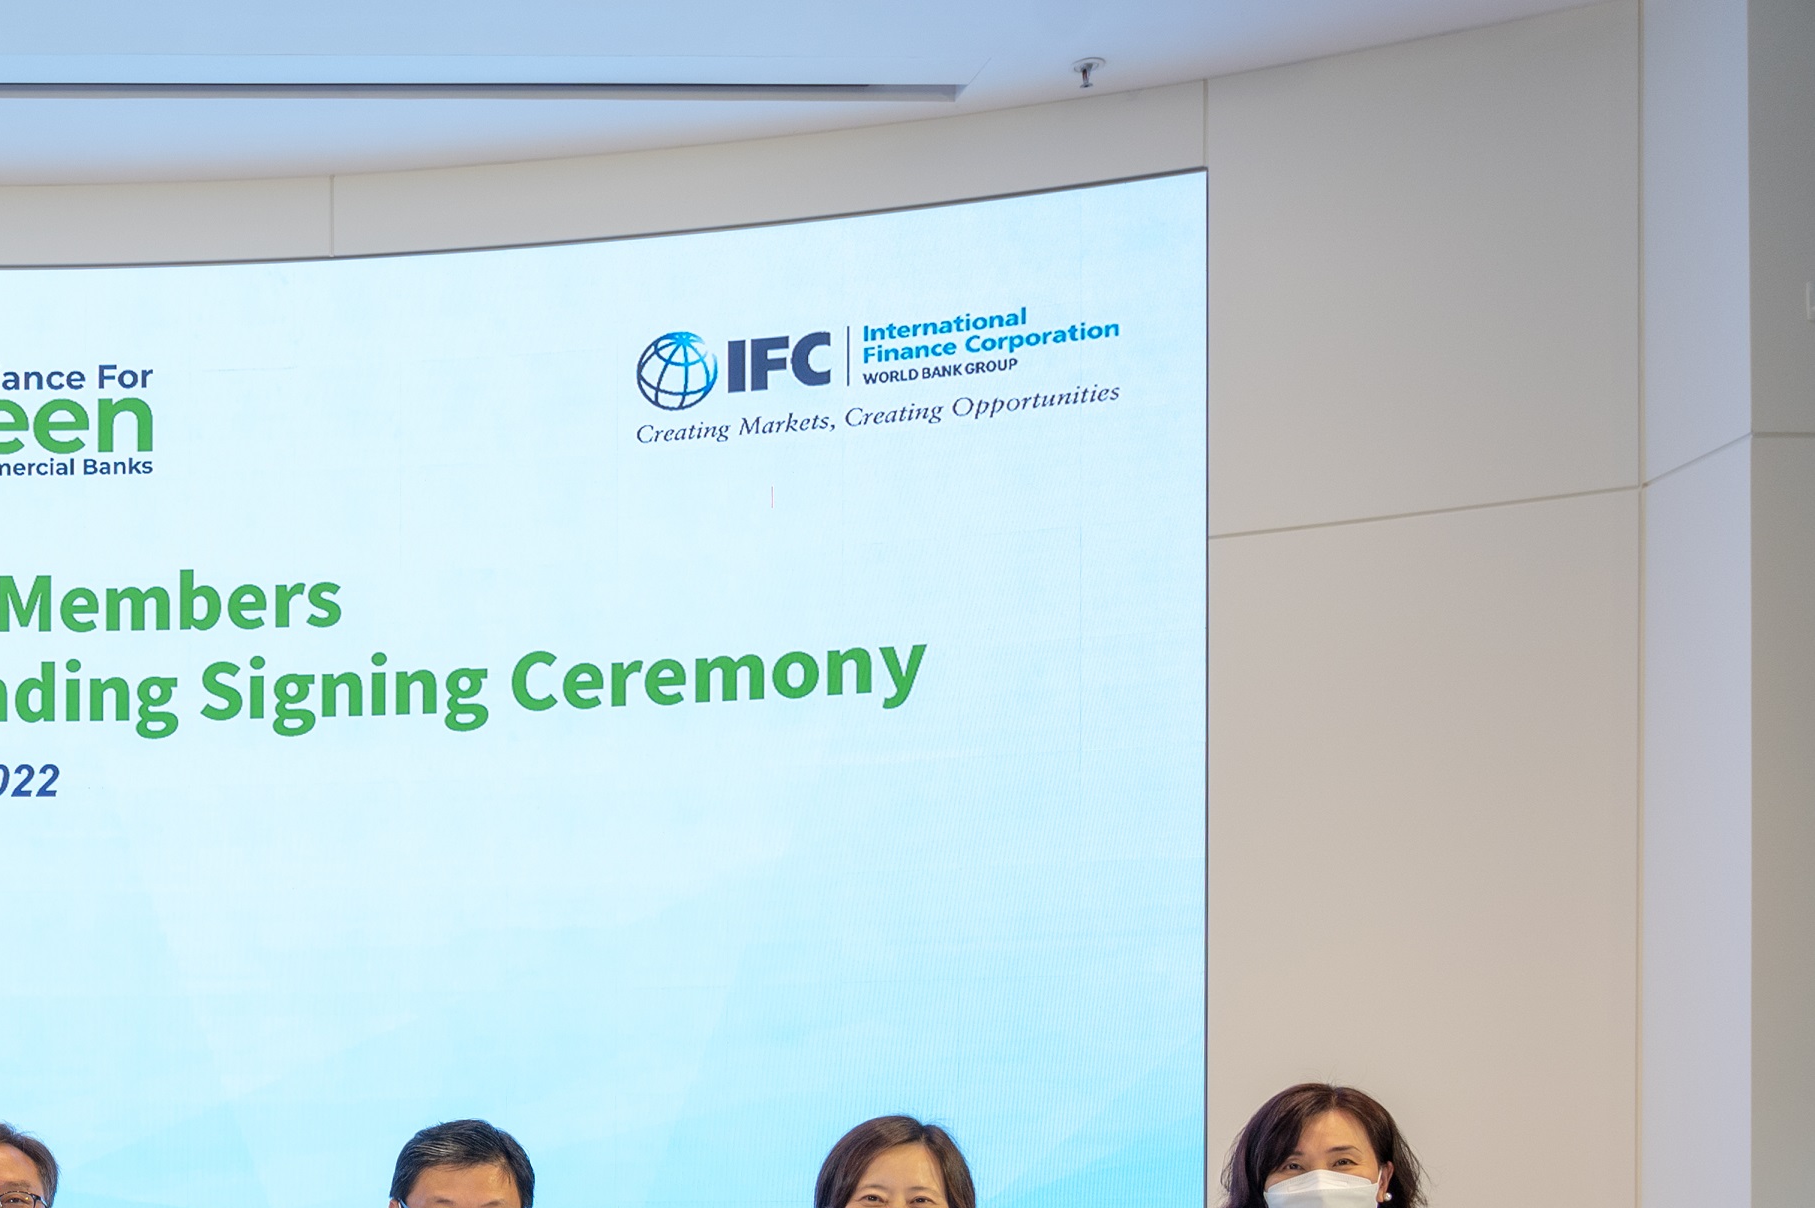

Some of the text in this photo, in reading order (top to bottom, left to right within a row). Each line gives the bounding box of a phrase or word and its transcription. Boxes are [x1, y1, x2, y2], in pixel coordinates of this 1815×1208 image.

[863, 307, 1027, 342] International
[863, 319, 1120, 364] Finance Corporation
[99, 365, 153, 391] For
[728, 330, 831, 393] IFC
[863, 357, 1018, 384] WORLD BANK GROUP
[636, 383, 1120, 443] Creating Markets, Creating Opportunities
[84, 458, 153, 476] Banks
[200, 652, 488, 737] Signing
[512, 644, 927, 712] Ceremony
